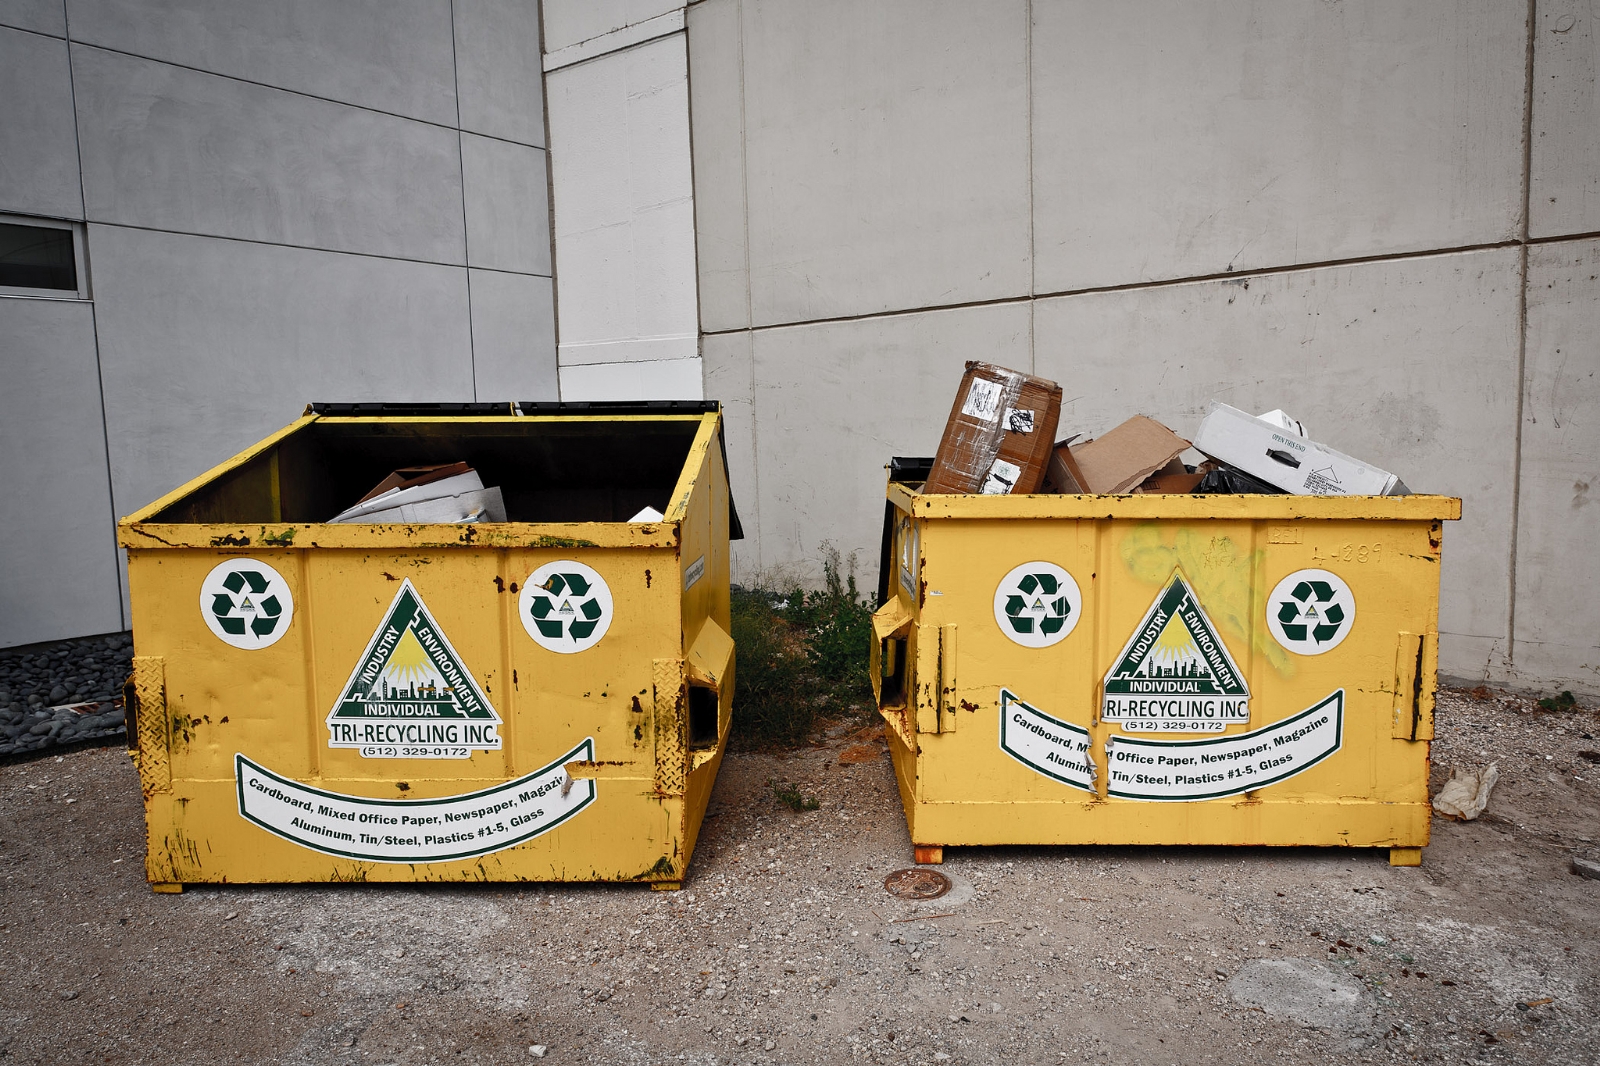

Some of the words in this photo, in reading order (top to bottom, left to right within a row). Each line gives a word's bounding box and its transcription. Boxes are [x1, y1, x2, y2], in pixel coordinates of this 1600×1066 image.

[1271, 433, 1285, 444] OPEN
[1284, 438, 1296, 449] THIS
[1295, 443, 1306, 452] END
[1128, 608, 1168, 664] INDUSTRY
[1184, 611, 1237, 690] ENVIRONMENT
[361, 625, 400, 685] INDUSTRY
[418, 626, 482, 714] ENVIRONMENT
[1129, 681, 1201, 693] INDIVIDUAL
[364, 704, 441, 717] INDIVIDUAL
[1125, 721, 1158, 731] (512)
[1162, 722, 1223, 731] 329-0172
[331, 723, 458, 743] TRI-RECYCLING
[464, 724, 499, 743] INC.
[1012, 713, 1073, 751] Cardboard,
[1116, 751, 1154, 765] Office
[1158, 755, 1198, 767] Paper,
[1201, 742, 1272, 764] Newspaper,
[1273, 715, 1329, 747] Magazine
[363, 747, 398, 757] (512)
[402, 747, 468, 757] 329-0172
[1112, 770, 1171, 787] Tin/Steel,
[1175, 772, 1225, 785] Plastics
[1227, 765, 1257, 779] #1-5,
[1259, 753, 1293, 771] Glass
[249, 777, 315, 813] Cardboard,
[317, 804, 356, 822] Mixed
[359, 813, 398, 825] Office
[401, 815, 442, 827] Paper,
[444, 799, 518, 823] Newspaper,
[518, 775, 563, 804] Magazi
[290, 816, 356, 843] Aluminum,
[359, 833, 421, 847] Tin/Steel,
[424, 832, 475, 845] Plastics
[477, 822, 509, 838] #1-5,
[510, 808, 545, 828] Glass
